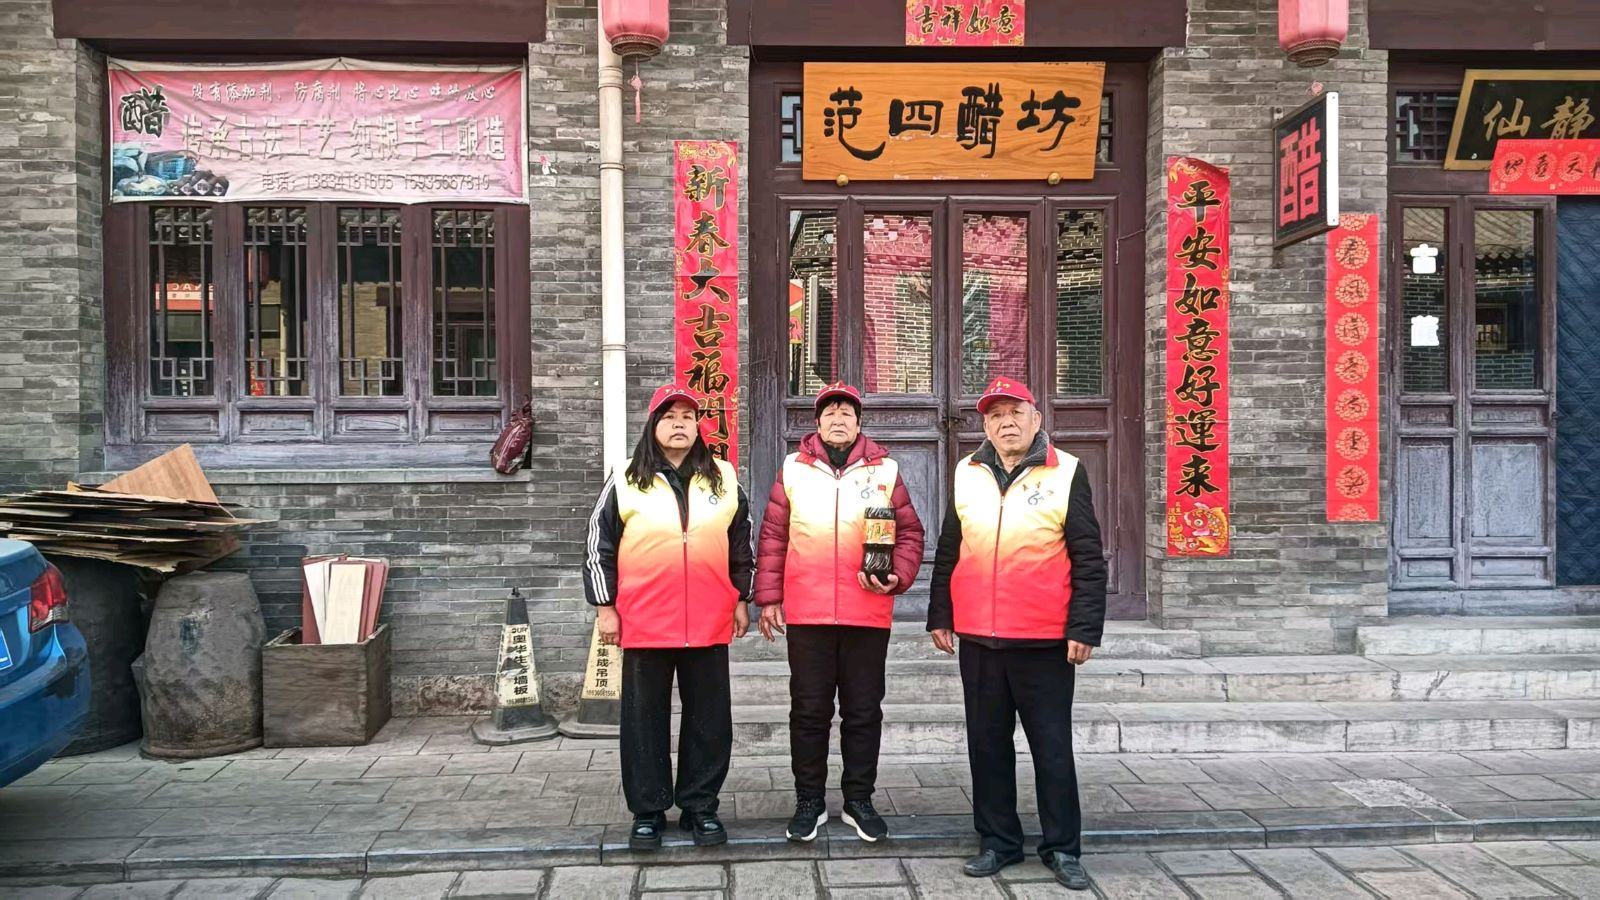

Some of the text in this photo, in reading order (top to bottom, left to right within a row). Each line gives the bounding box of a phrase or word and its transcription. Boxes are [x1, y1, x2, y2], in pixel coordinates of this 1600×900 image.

[915, 6, 1016, 34] 吉祥如意
[119, 84, 171, 138] 醋
[824, 82, 1081, 161] 范四醋坊
[1280, 116, 1321, 227] 醋
[1174, 180, 1222, 498] 平安如意好運来
